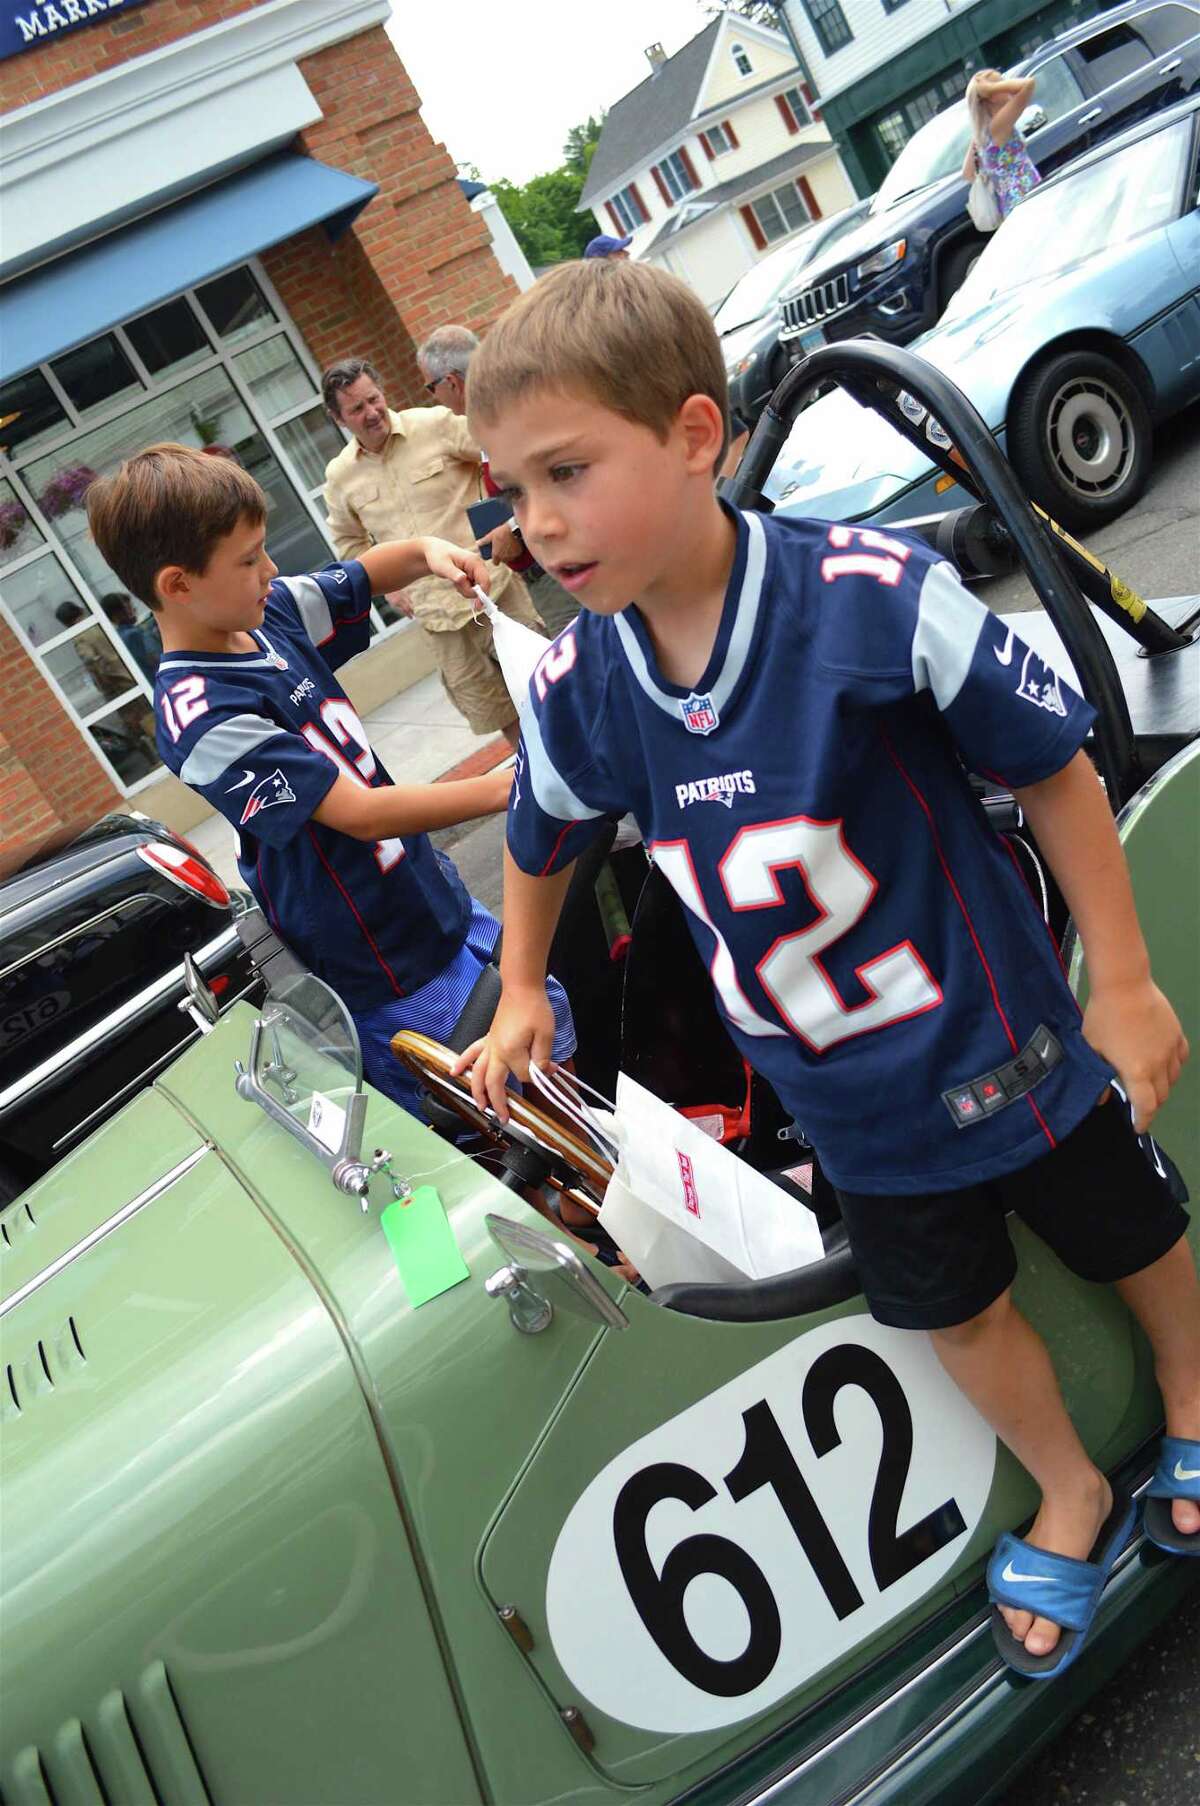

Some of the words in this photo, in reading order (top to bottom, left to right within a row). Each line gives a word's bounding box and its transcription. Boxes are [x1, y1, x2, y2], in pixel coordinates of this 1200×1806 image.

[161, 673, 209, 743] 12
[687, 711, 714, 729] NFL
[675, 770, 756, 809] PATRIOTS
[650, 815, 944, 1055] 12
[613, 1343, 968, 1698] 612
